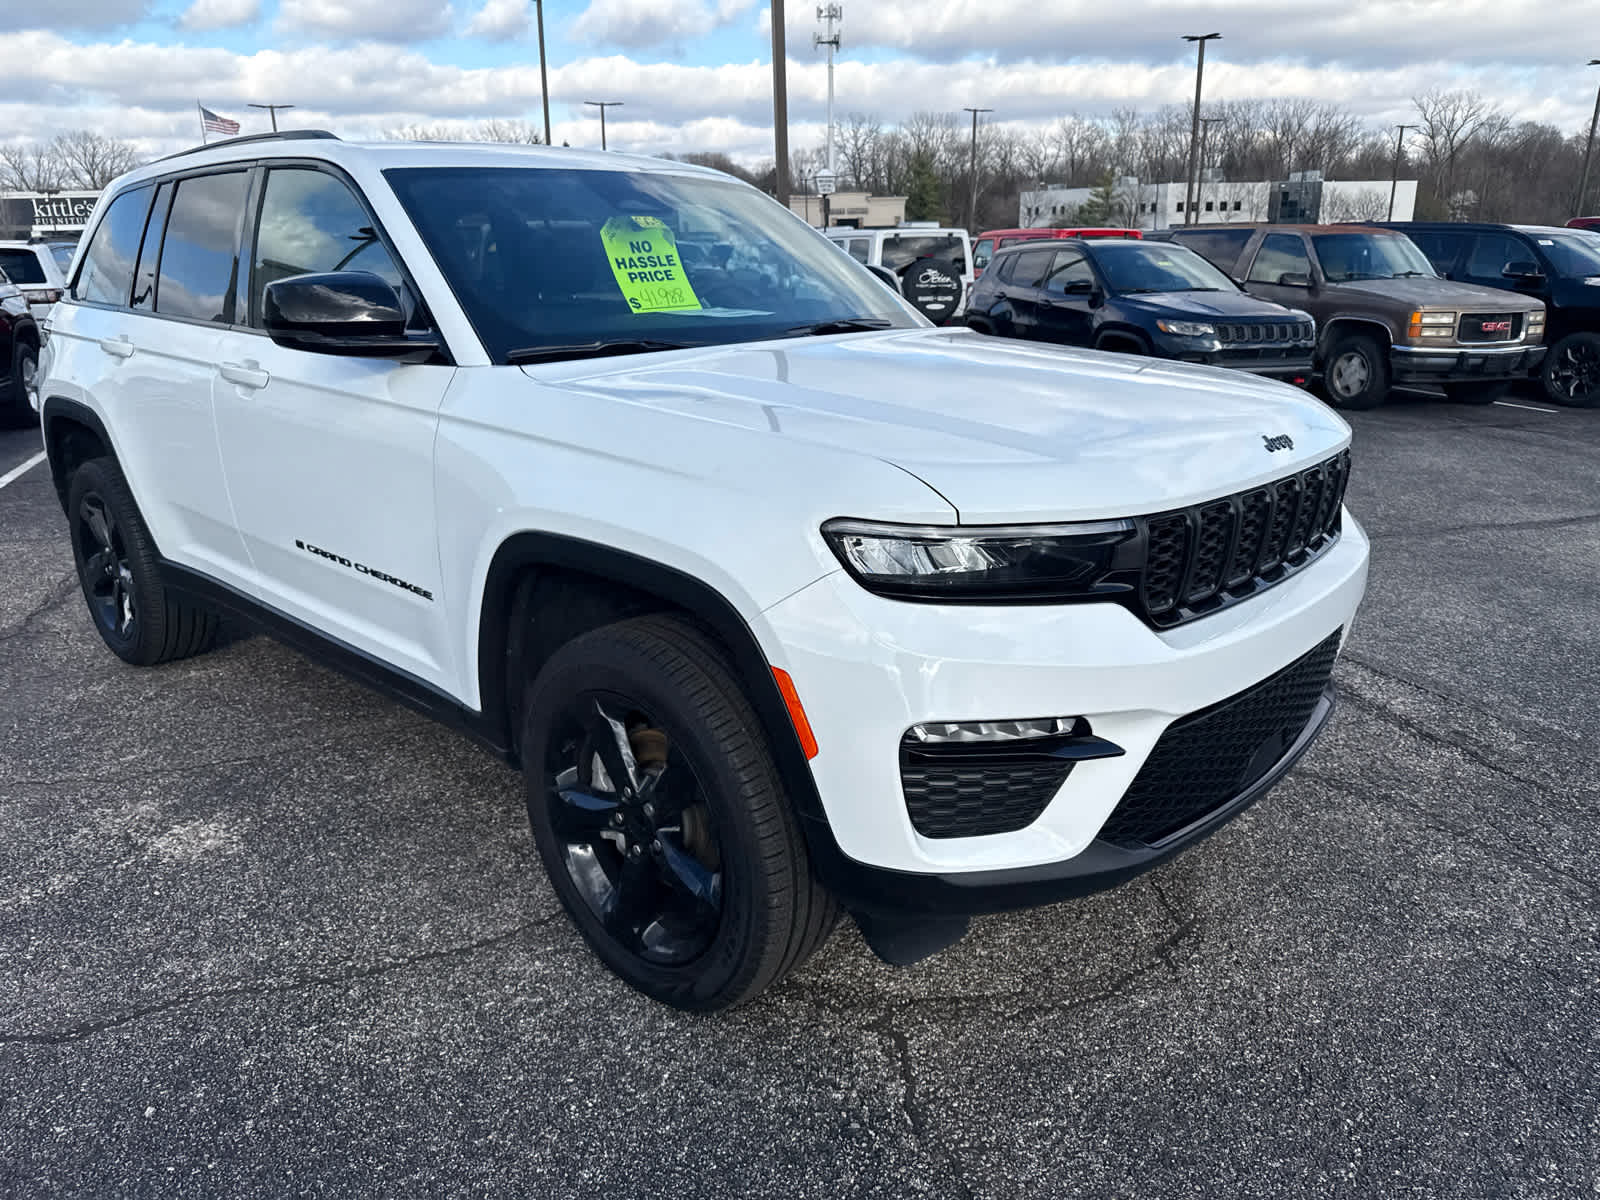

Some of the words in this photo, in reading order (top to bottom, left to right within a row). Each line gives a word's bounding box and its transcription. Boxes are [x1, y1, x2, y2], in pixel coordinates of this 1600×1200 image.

[32, 198, 94, 217] kittle's
[629, 240, 652, 254] NO
[615, 254, 677, 270] HASSLE
[628, 269, 676, 284] PRICE
[1482, 321, 1511, 332] GMC
[1261, 434, 1294, 453] Jeep
[306, 544, 352, 568] GRAND
[354, 562, 434, 602] CHEROKEE
